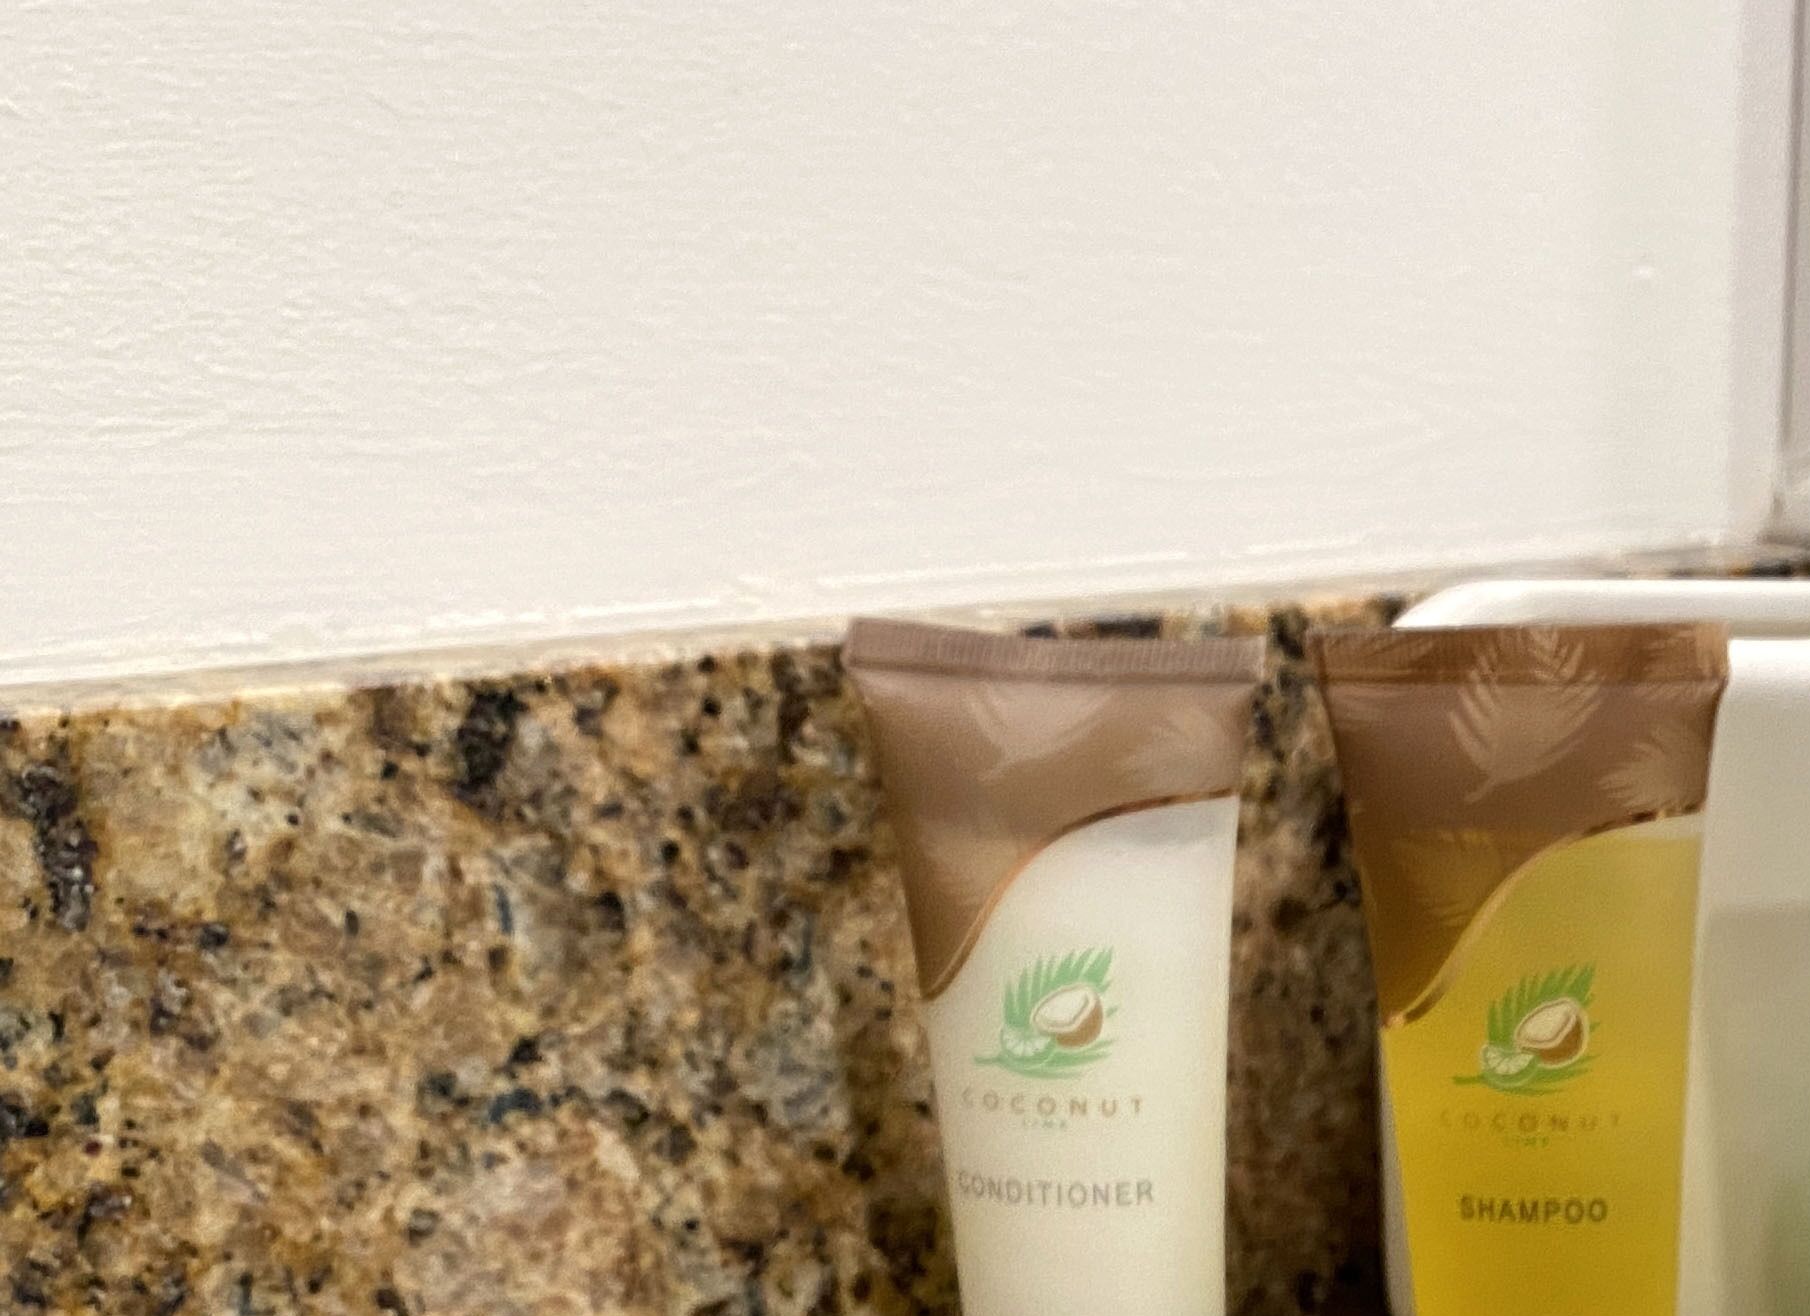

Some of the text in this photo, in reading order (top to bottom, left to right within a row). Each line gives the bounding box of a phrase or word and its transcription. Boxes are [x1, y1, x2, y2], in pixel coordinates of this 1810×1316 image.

[962, 1087, 1143, 1119] COCONUT
[958, 1170, 1155, 1208] CONDITIONER
[1458, 1193, 1609, 1225] SHAMPOO
